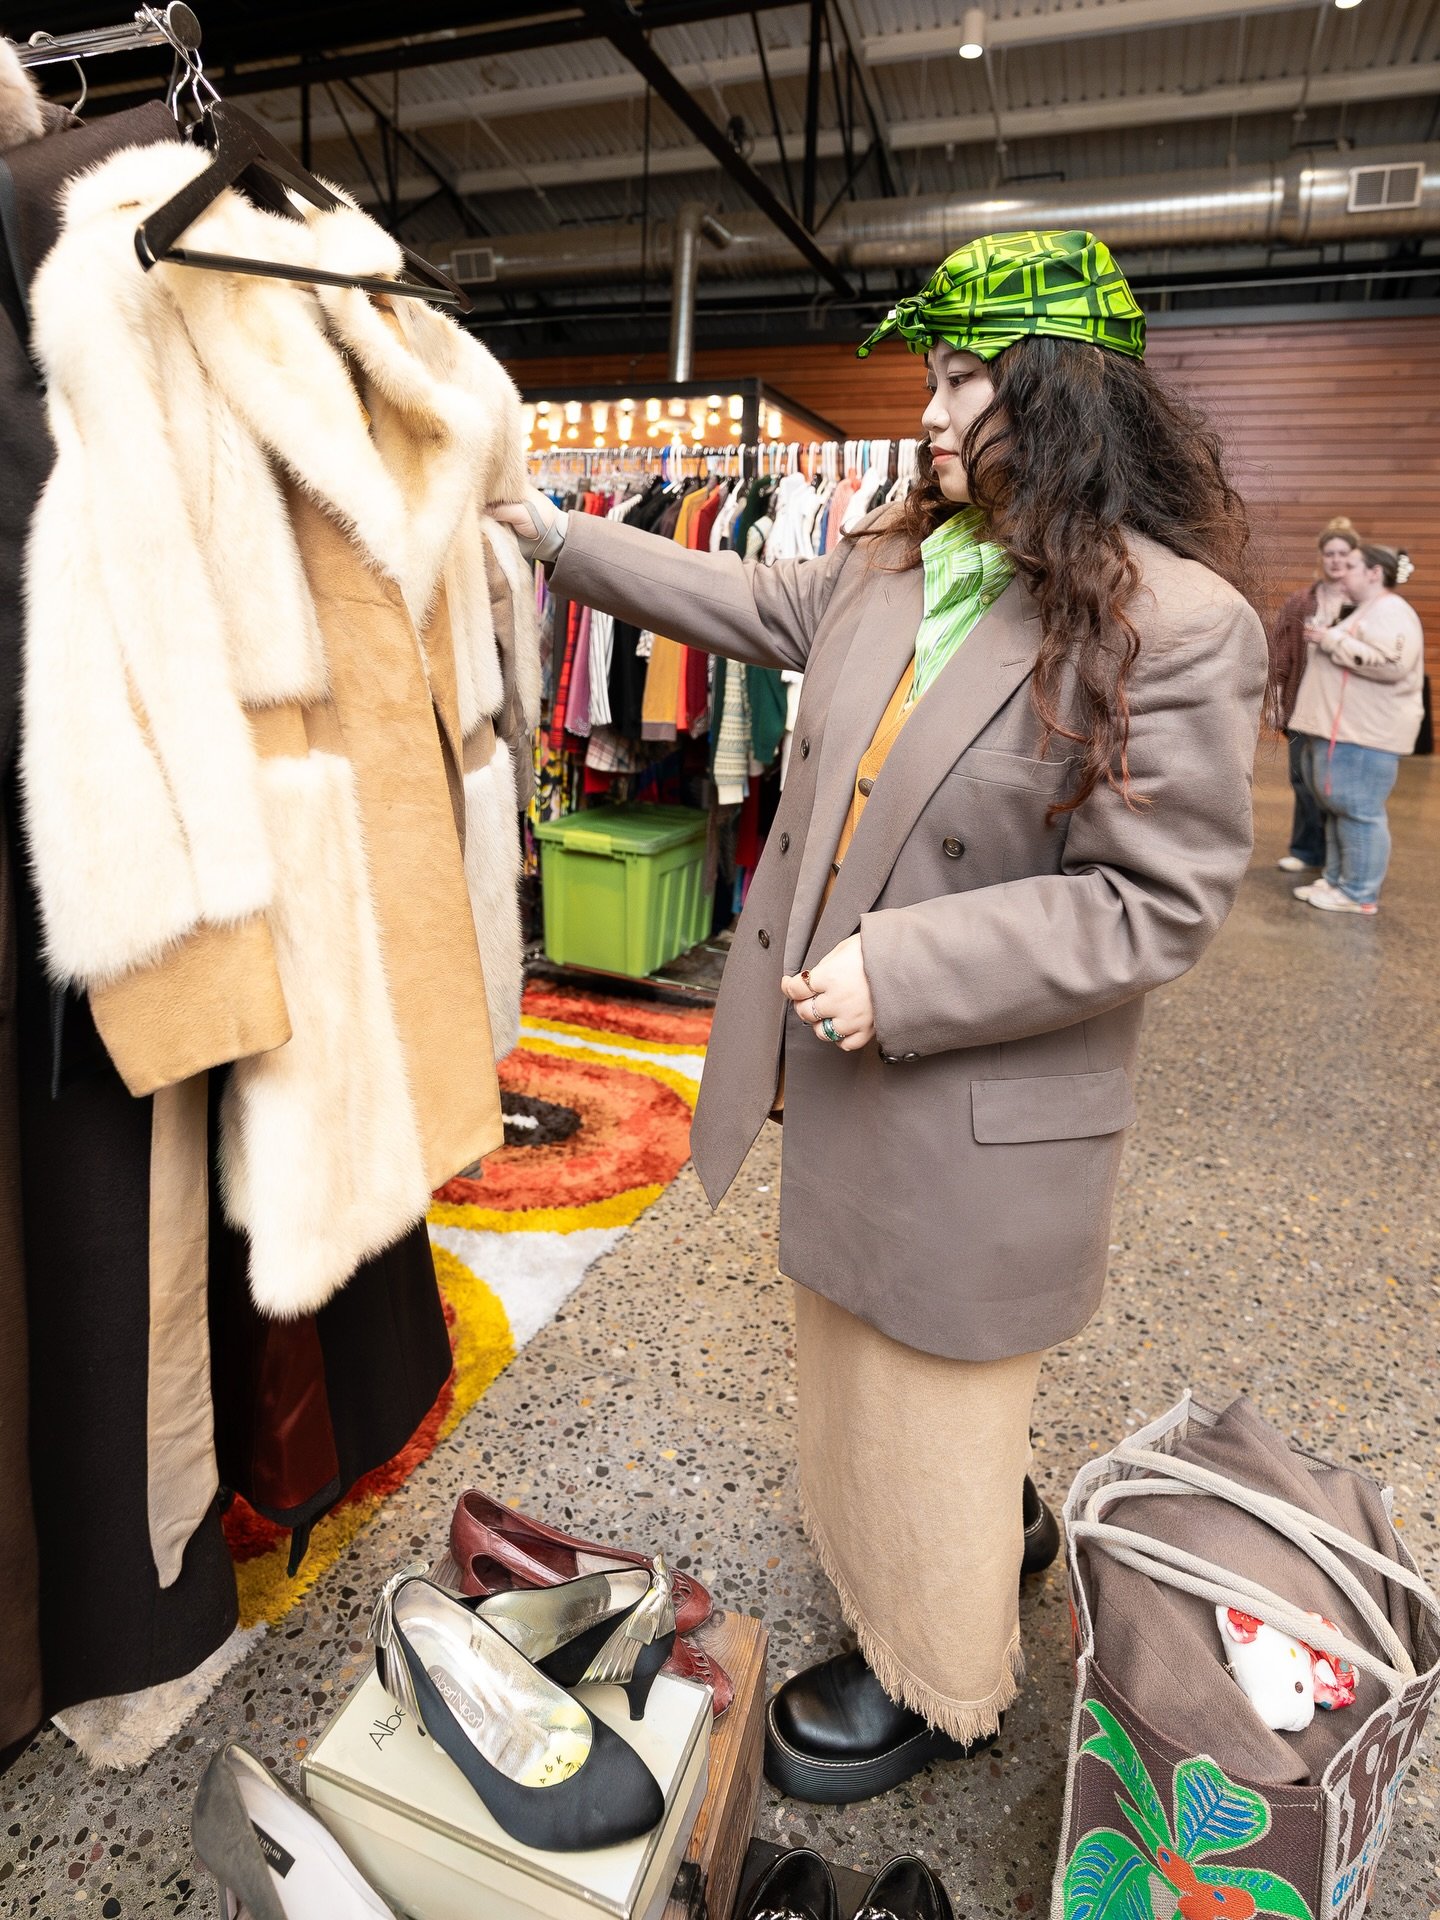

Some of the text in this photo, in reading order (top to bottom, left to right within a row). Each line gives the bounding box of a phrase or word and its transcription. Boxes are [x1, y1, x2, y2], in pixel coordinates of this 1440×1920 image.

[431, 1672, 484, 1729] Albert Nipon
[259, 1837, 282, 1861] TAYLOR
